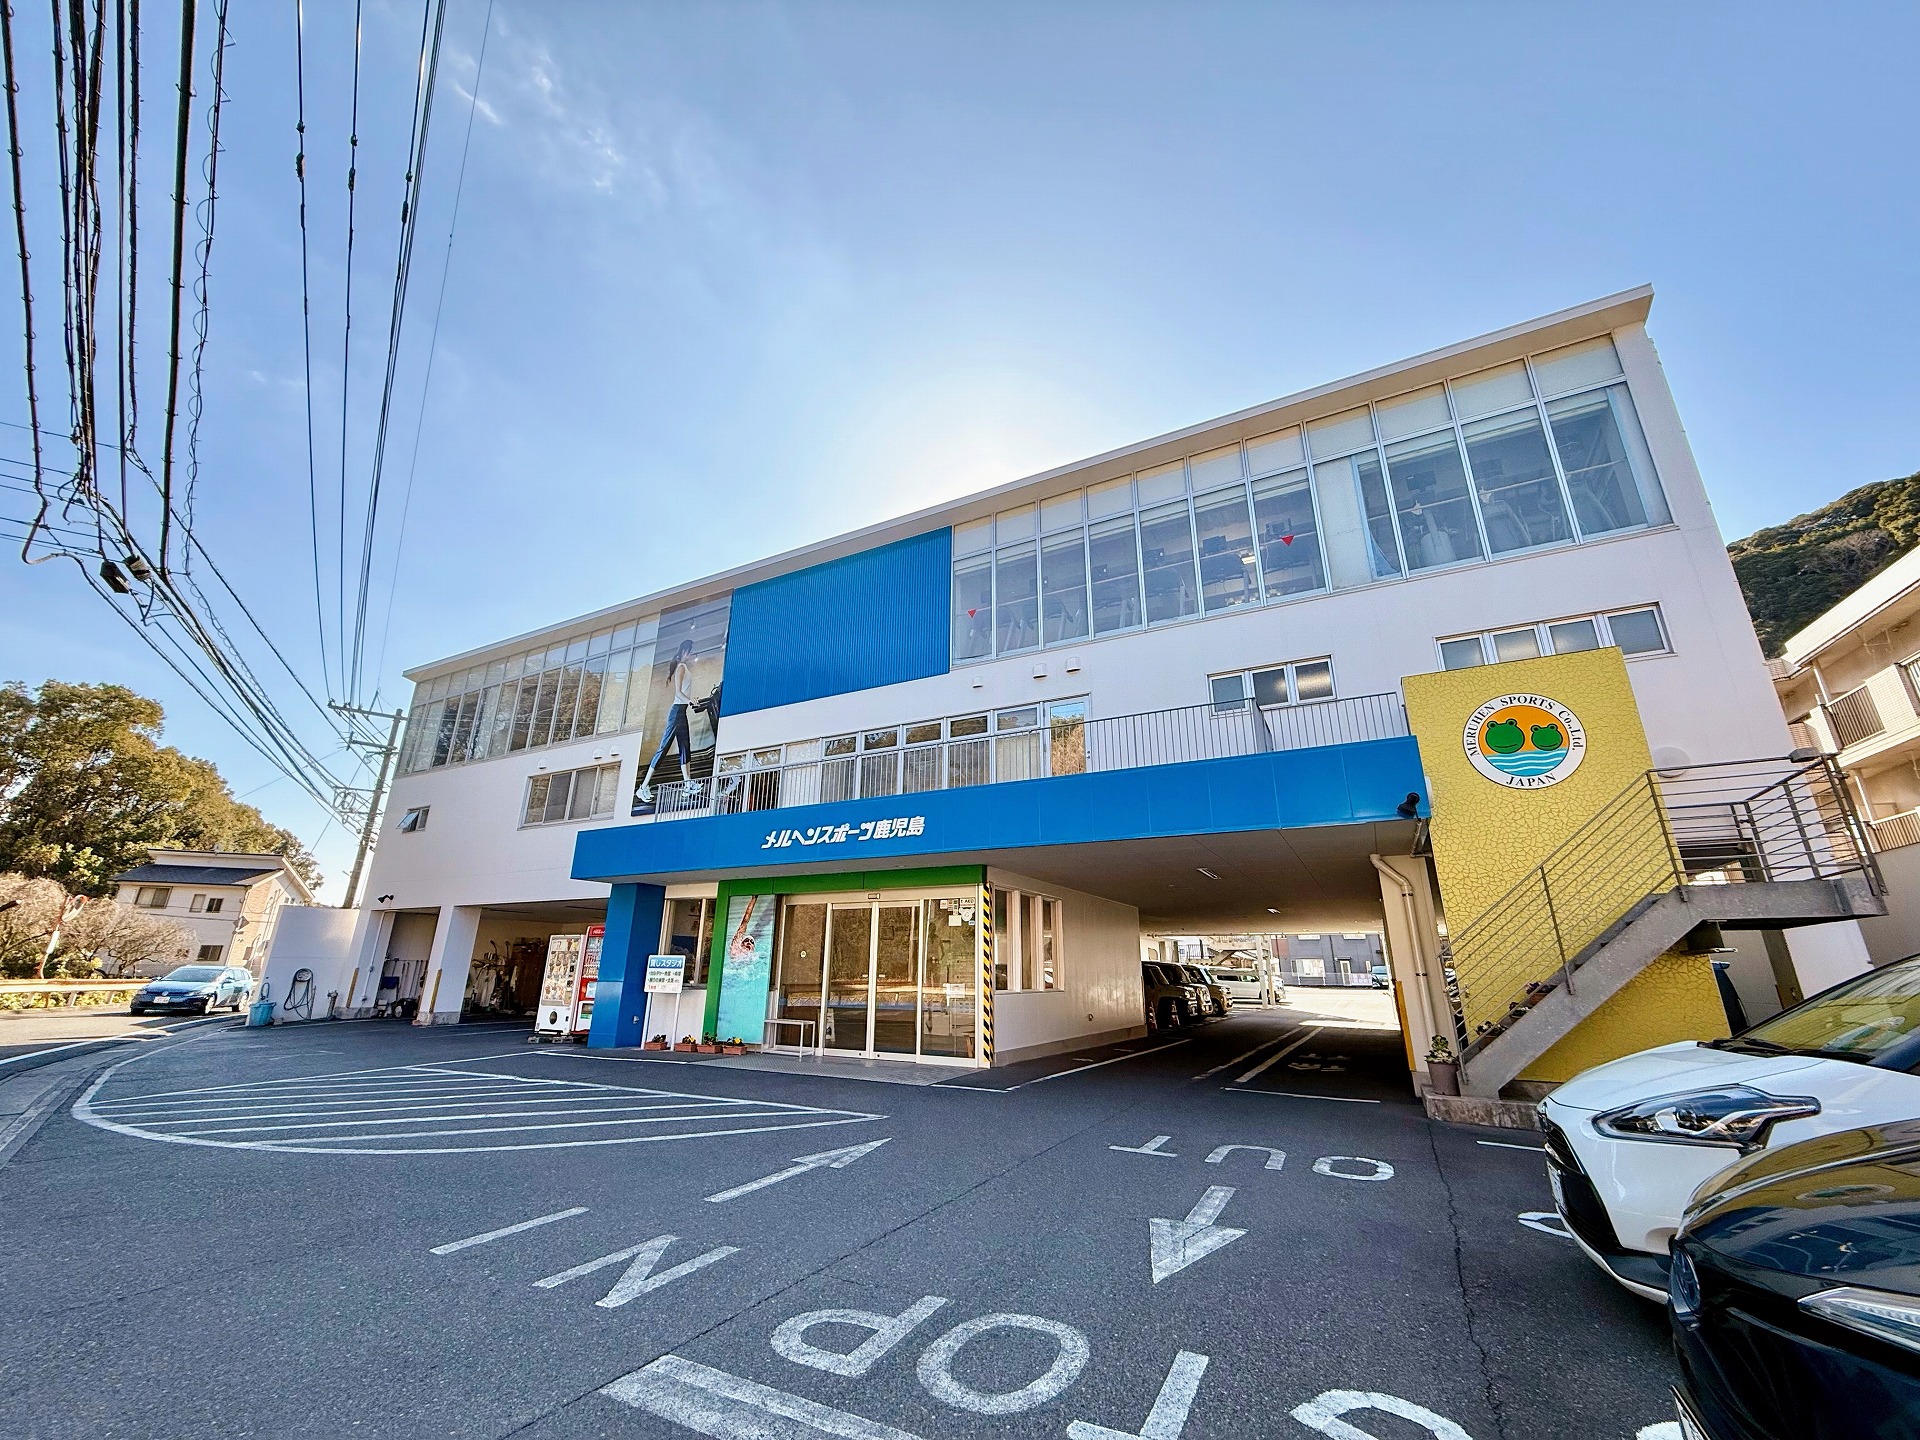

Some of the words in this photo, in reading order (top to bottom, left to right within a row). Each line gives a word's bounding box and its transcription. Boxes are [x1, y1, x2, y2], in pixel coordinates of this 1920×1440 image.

[1466, 703, 1495, 757] MERUHEN
[1500, 695, 1555, 710] SPORTS
[1505, 772, 1557, 788] JAPAN
[761, 816, 926, 849] メルヘンスポーツ鹿児島
[650, 959, 682, 968] 貸しスタジオ
[1108, 1135, 1396, 1182] OUT
